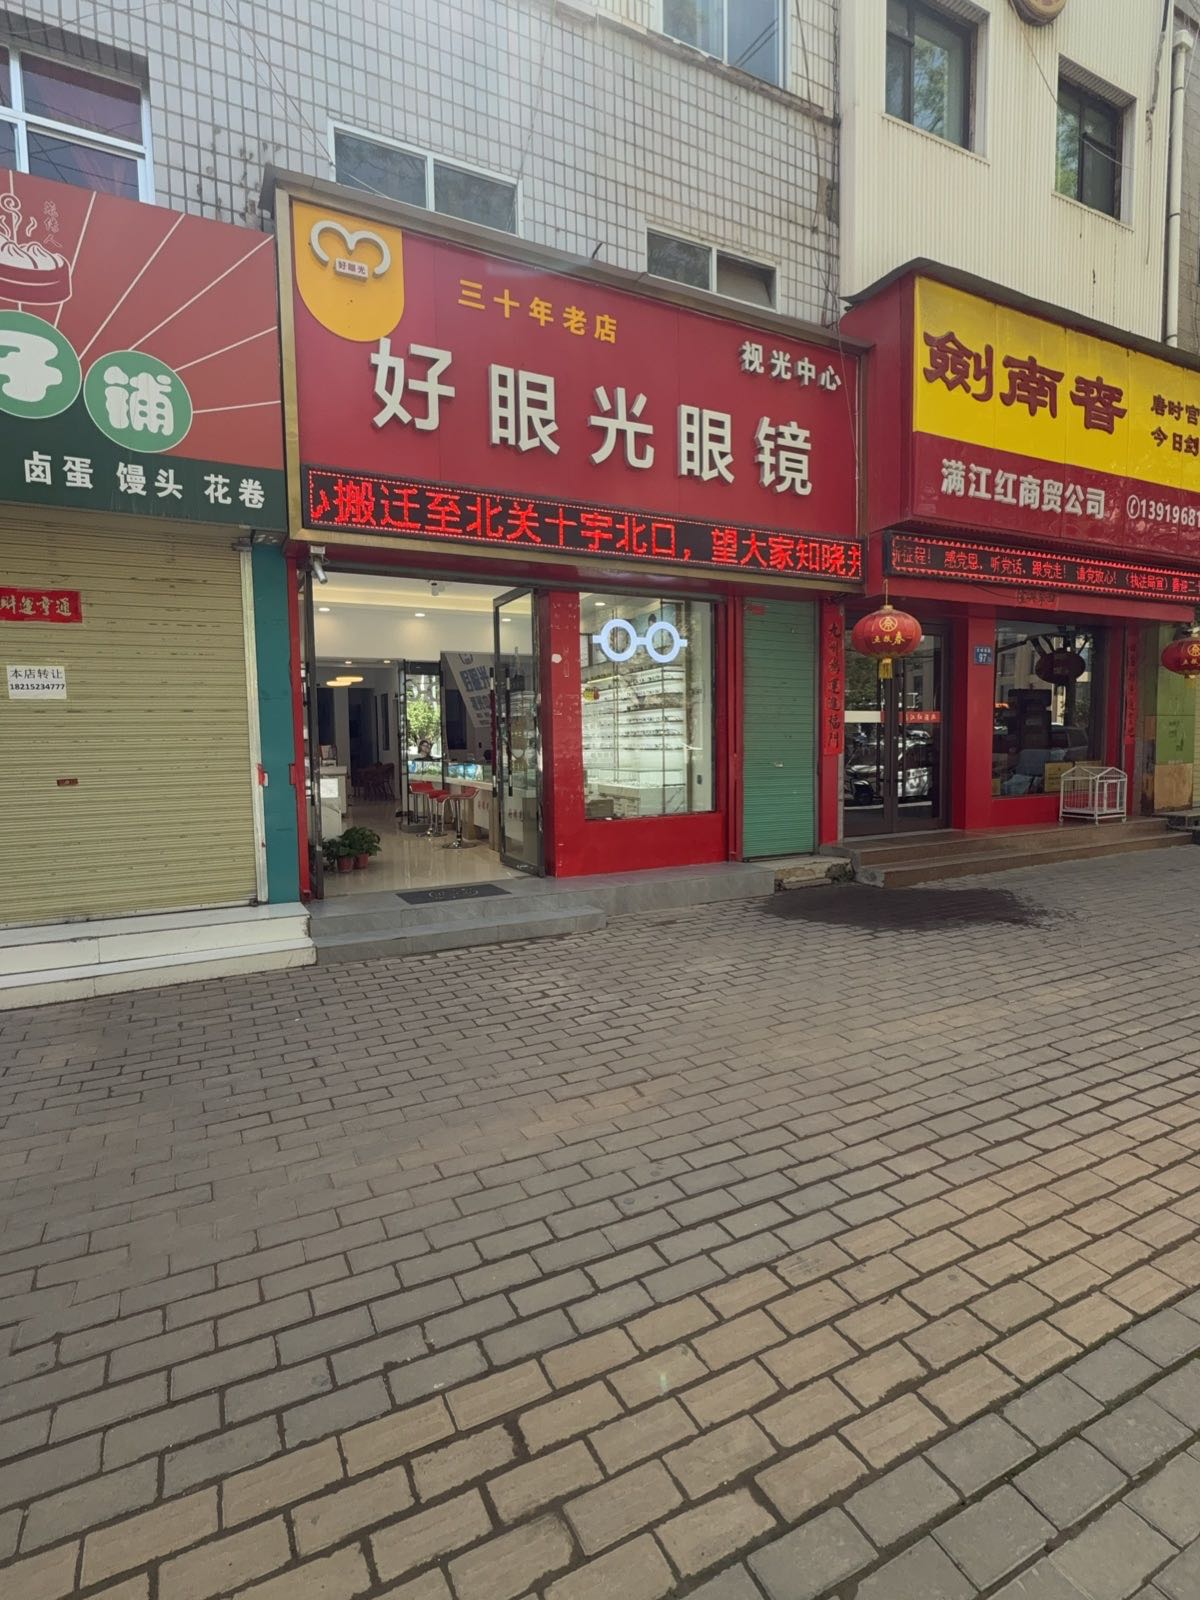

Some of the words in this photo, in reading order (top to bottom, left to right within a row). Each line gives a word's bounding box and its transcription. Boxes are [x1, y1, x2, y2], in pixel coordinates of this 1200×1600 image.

[458, 279, 617, 343] 三十年老店
[739, 340, 842, 391] 视光中心
[369, 336, 813, 496] 好眼光眼镜
[24, 452, 94, 489] 卤蛋
[117, 462, 183, 499] 馒头
[204, 474, 265, 509] 花卷
[941, 459, 1105, 519] 满江红商贸公司
[9, 668, 63, 680] 本店转让
[10, 683, 65, 691] 18215234777
